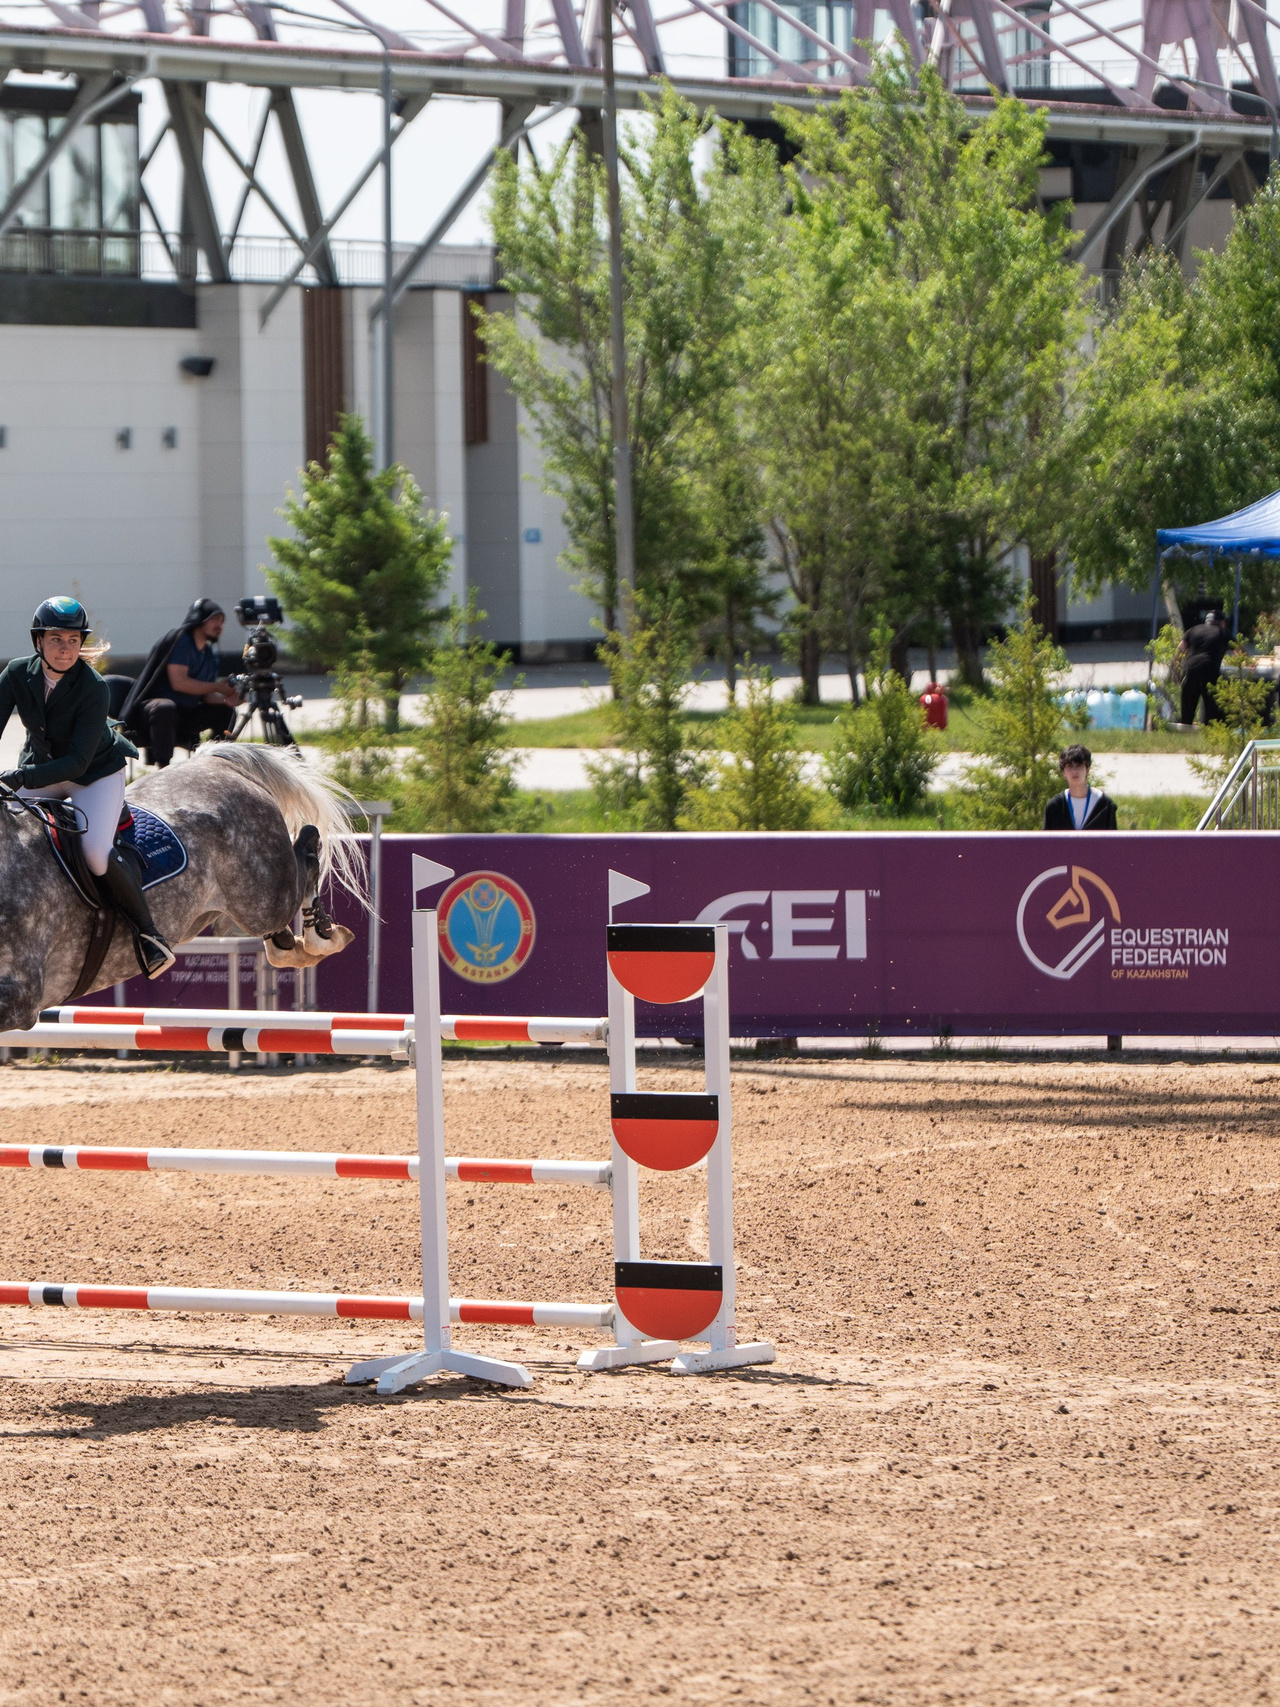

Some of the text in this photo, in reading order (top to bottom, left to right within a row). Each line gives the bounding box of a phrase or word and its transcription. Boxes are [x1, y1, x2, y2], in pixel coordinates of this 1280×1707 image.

[146, 845, 172, 858] WINDEREN
[1110, 928, 1229, 946] EQUESTRIAN
[1111, 948, 1227, 966] FEDERATION
[462, 965, 510, 979] ASTANA
[1111, 969, 1189, 979] OF KAZAKHSTAN
